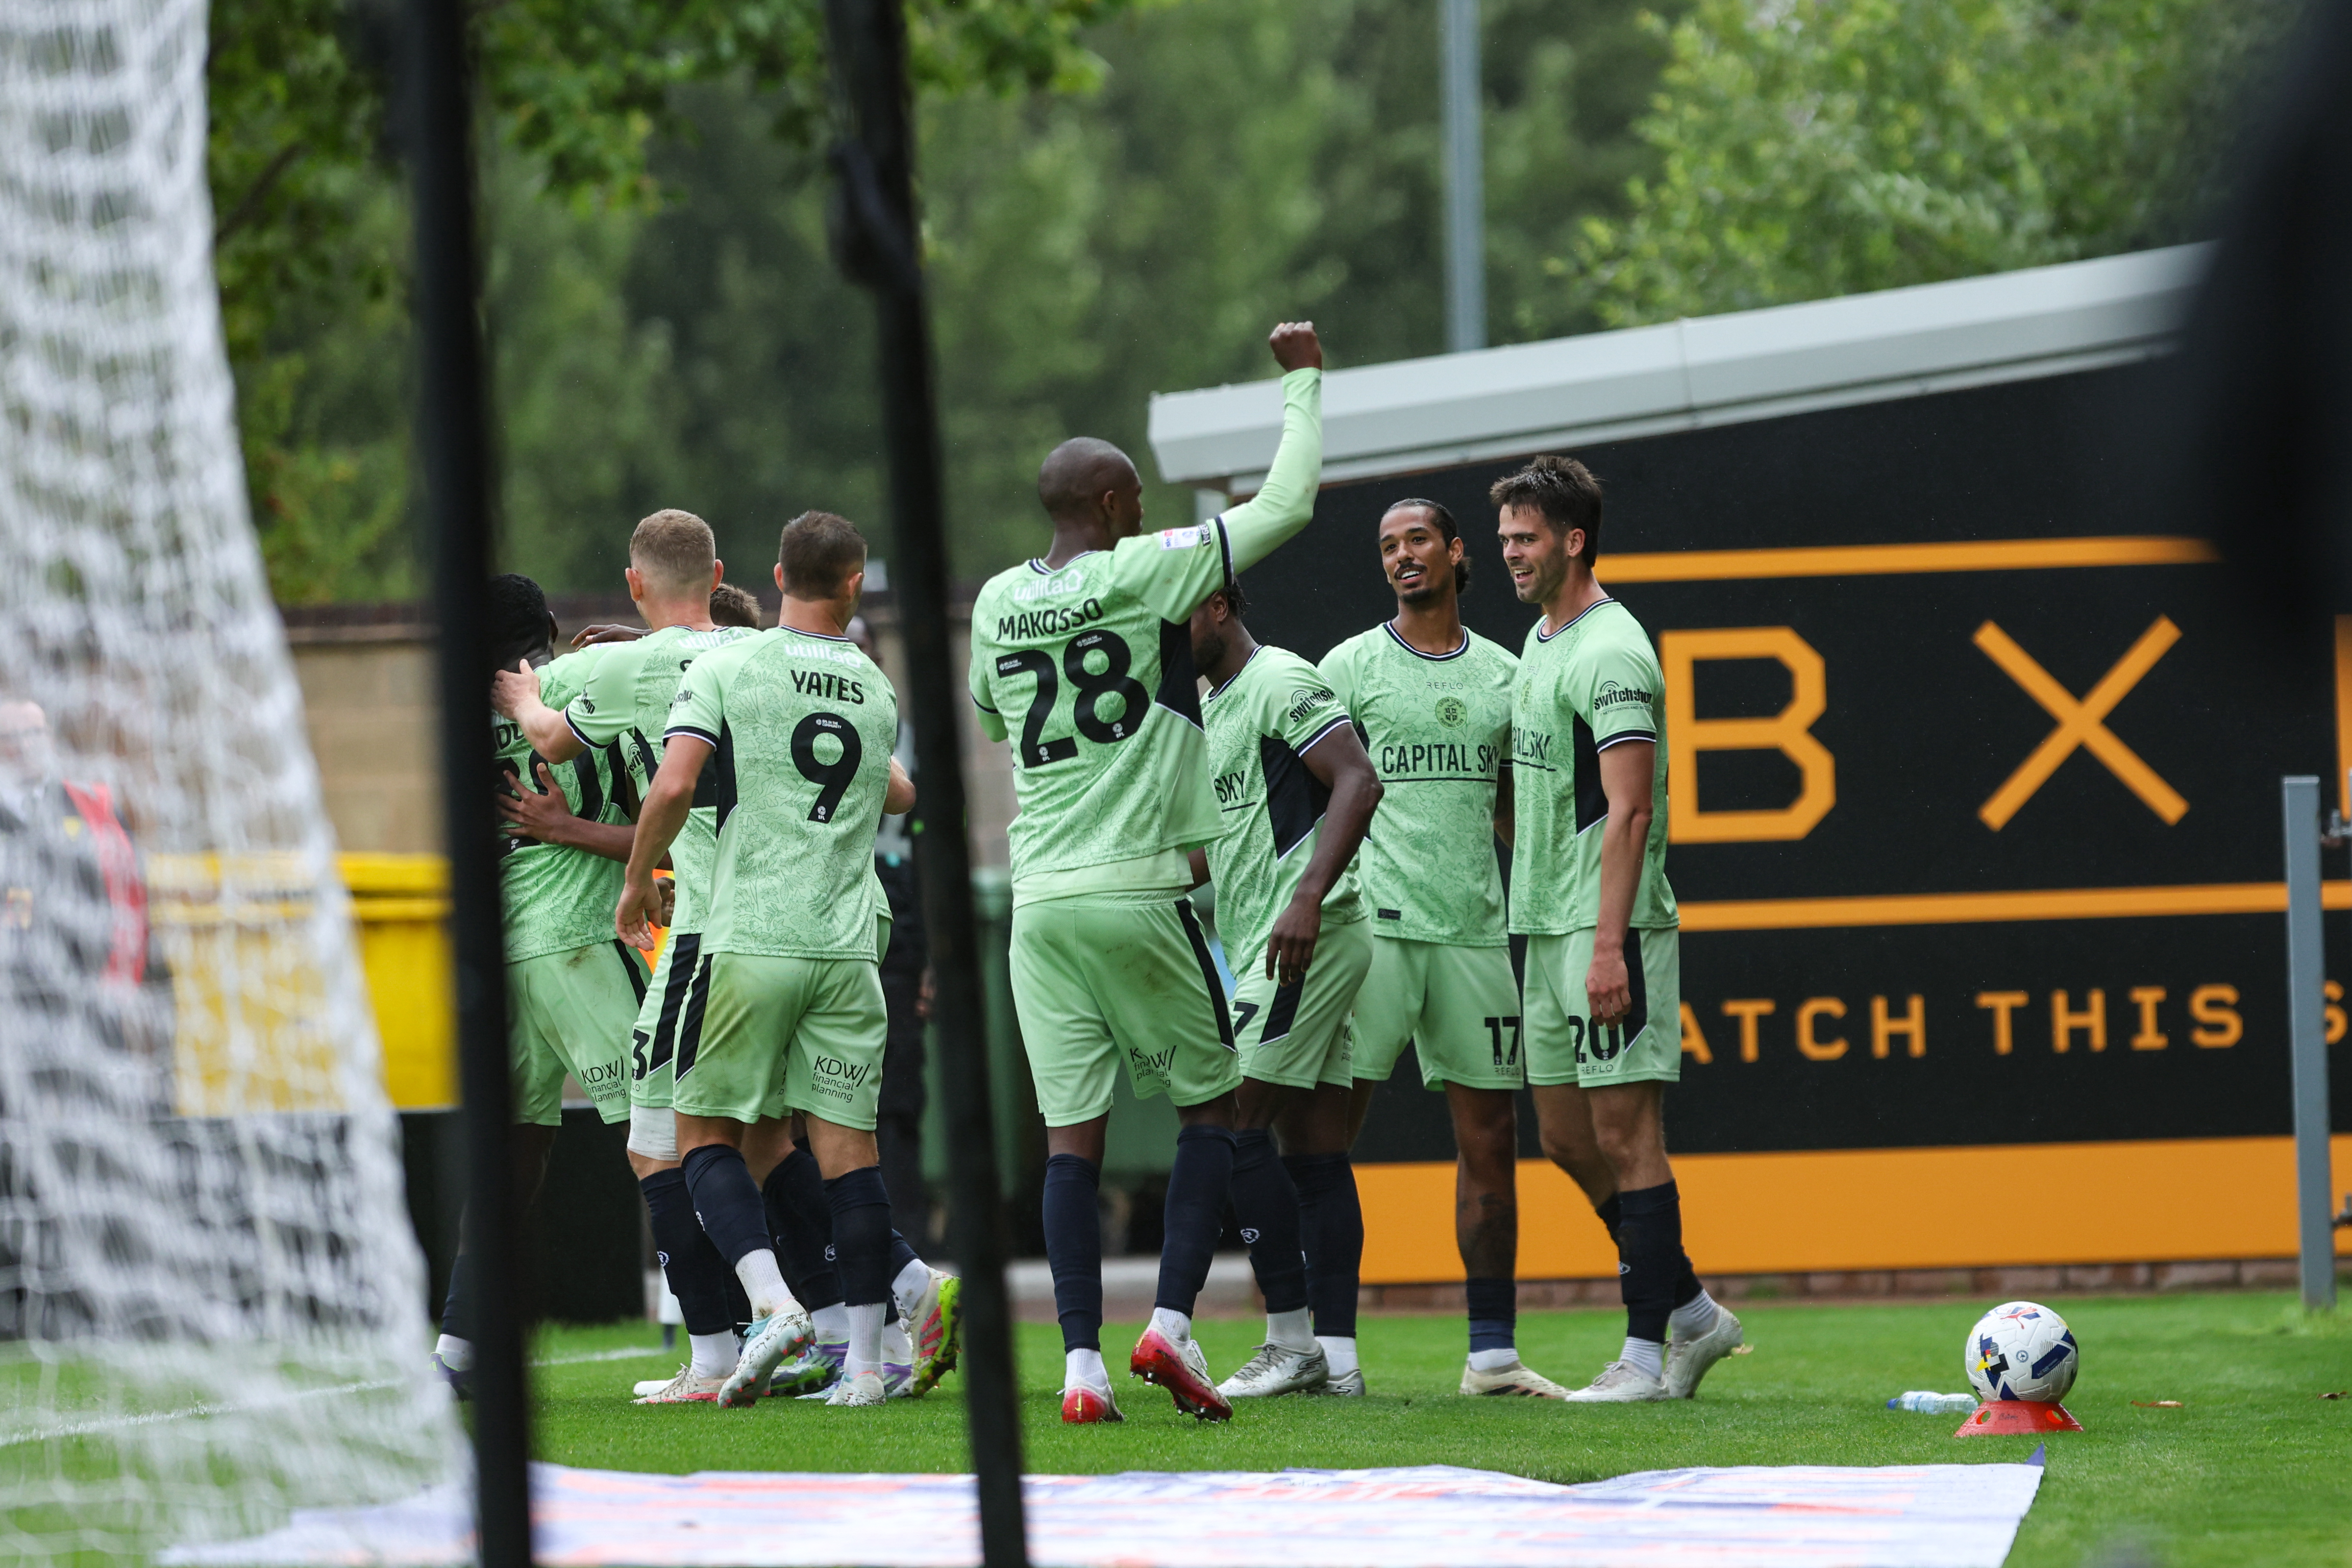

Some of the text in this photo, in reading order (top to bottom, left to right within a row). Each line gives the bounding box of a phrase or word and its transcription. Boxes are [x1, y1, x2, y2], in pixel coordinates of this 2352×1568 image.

[996, 598, 1104, 641] MAKOSSO
[784, 643, 845, 664] utilita
[790, 669, 864, 705] YATES
[995, 630, 1150, 769] 28
[790, 713, 862, 825] 9
[1382, 744, 1500, 774] CAPITAL SKY
[1214, 770, 1245, 803] SKY
[1233, 1002, 1260, 1038] 7
[1975, 984, 2243, 1055] THIS
[632, 1028, 650, 1080] 3
[1484, 1016, 1520, 1065] 17
[1568, 1015, 1620, 1061] 20
[593, 1089, 627, 1102] lanning
[812, 1073, 855, 1090] financial
[812, 1083, 853, 1103] planning
